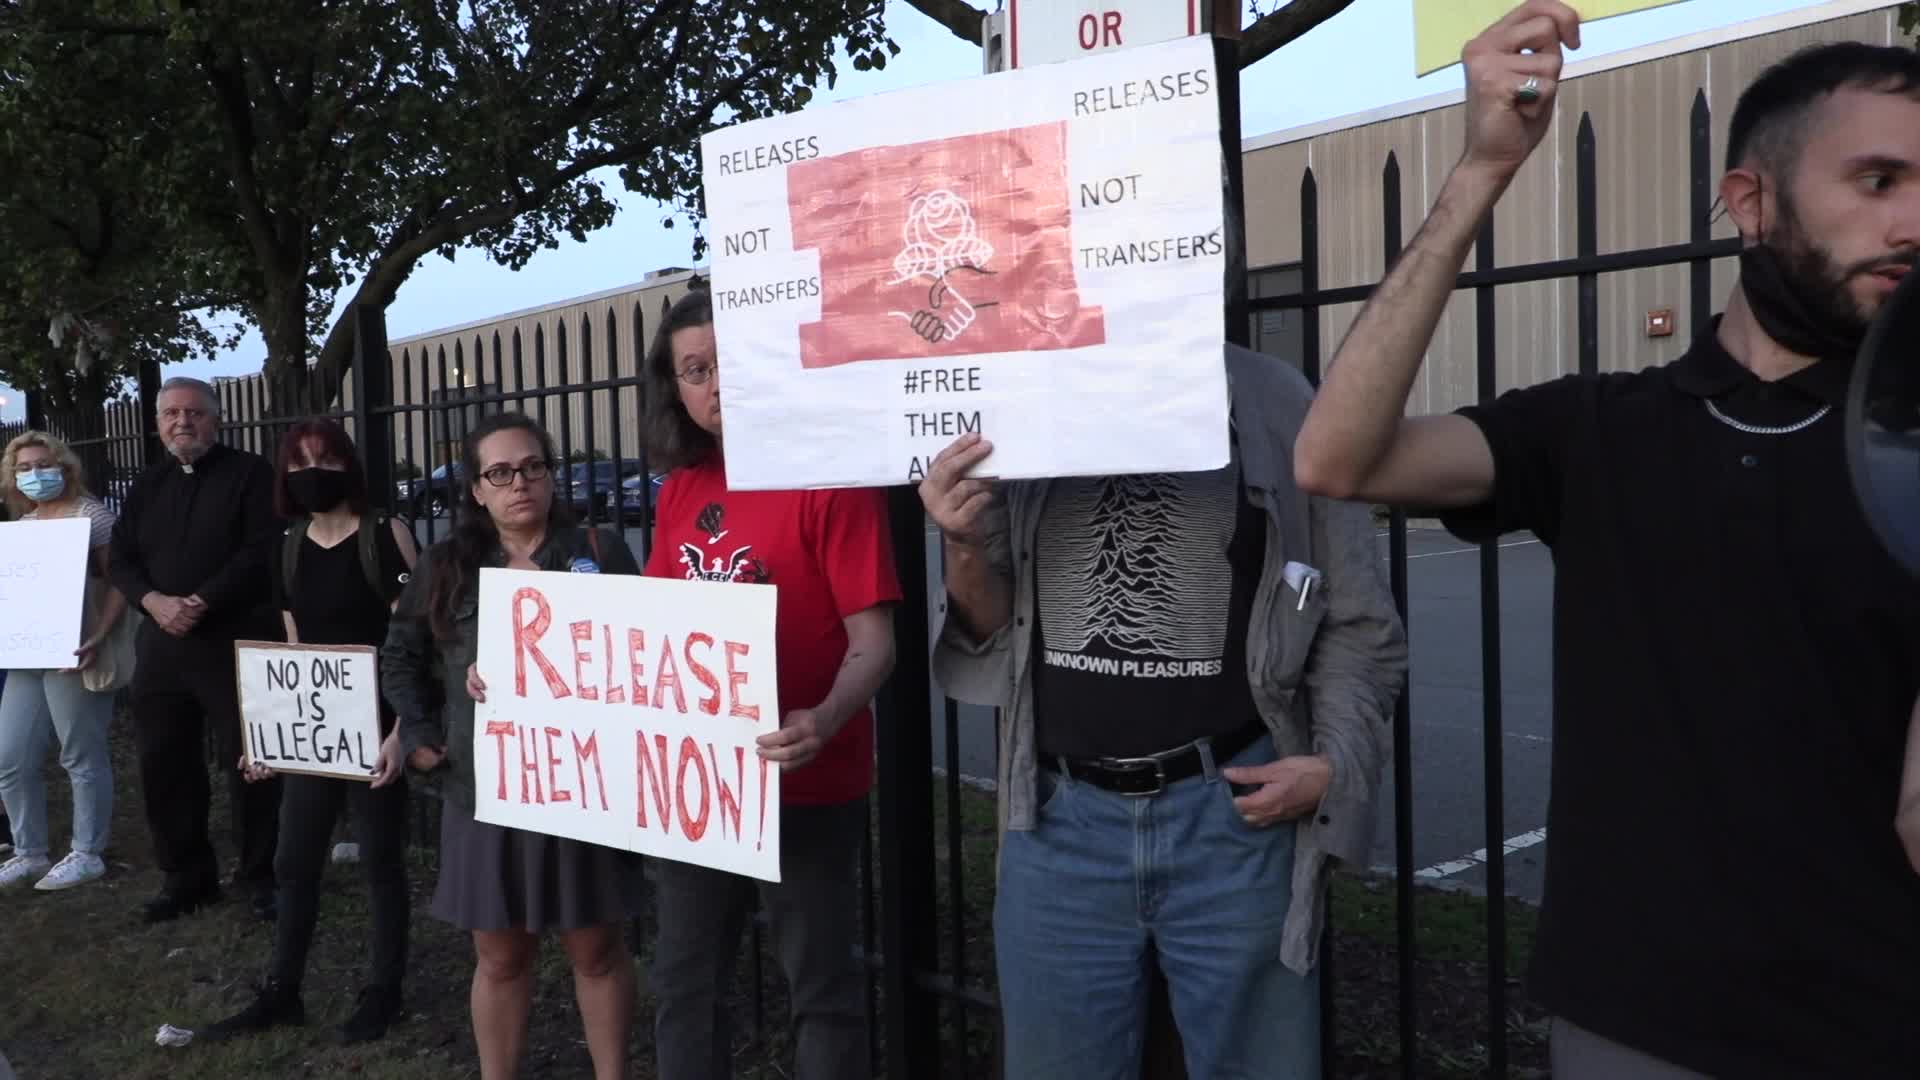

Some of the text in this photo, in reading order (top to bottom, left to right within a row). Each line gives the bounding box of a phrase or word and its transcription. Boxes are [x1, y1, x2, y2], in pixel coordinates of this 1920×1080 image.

[1078, 10, 1122, 50] OR
[1073, 68, 1211, 118] RELEASES
[718, 135, 820, 176] RELEASES
[1080, 173, 1143, 208] NOT
[724, 228, 771, 257] NOT
[1079, 232, 1223, 270] TRANSFERS
[716, 275, 820, 312] TRANSFERS
[904, 367, 982, 395] #FREE
[904, 411, 982, 437] THEM
[511, 586, 761, 721] RELEASE
[1121, 658, 1223, 679] PLEASURES
[266, 658, 353, 691] NO ONE
[298, 691, 325, 722] IS
[249, 722, 375, 770] ILLEGAL
[486, 720, 769, 852] THEM NOW!
